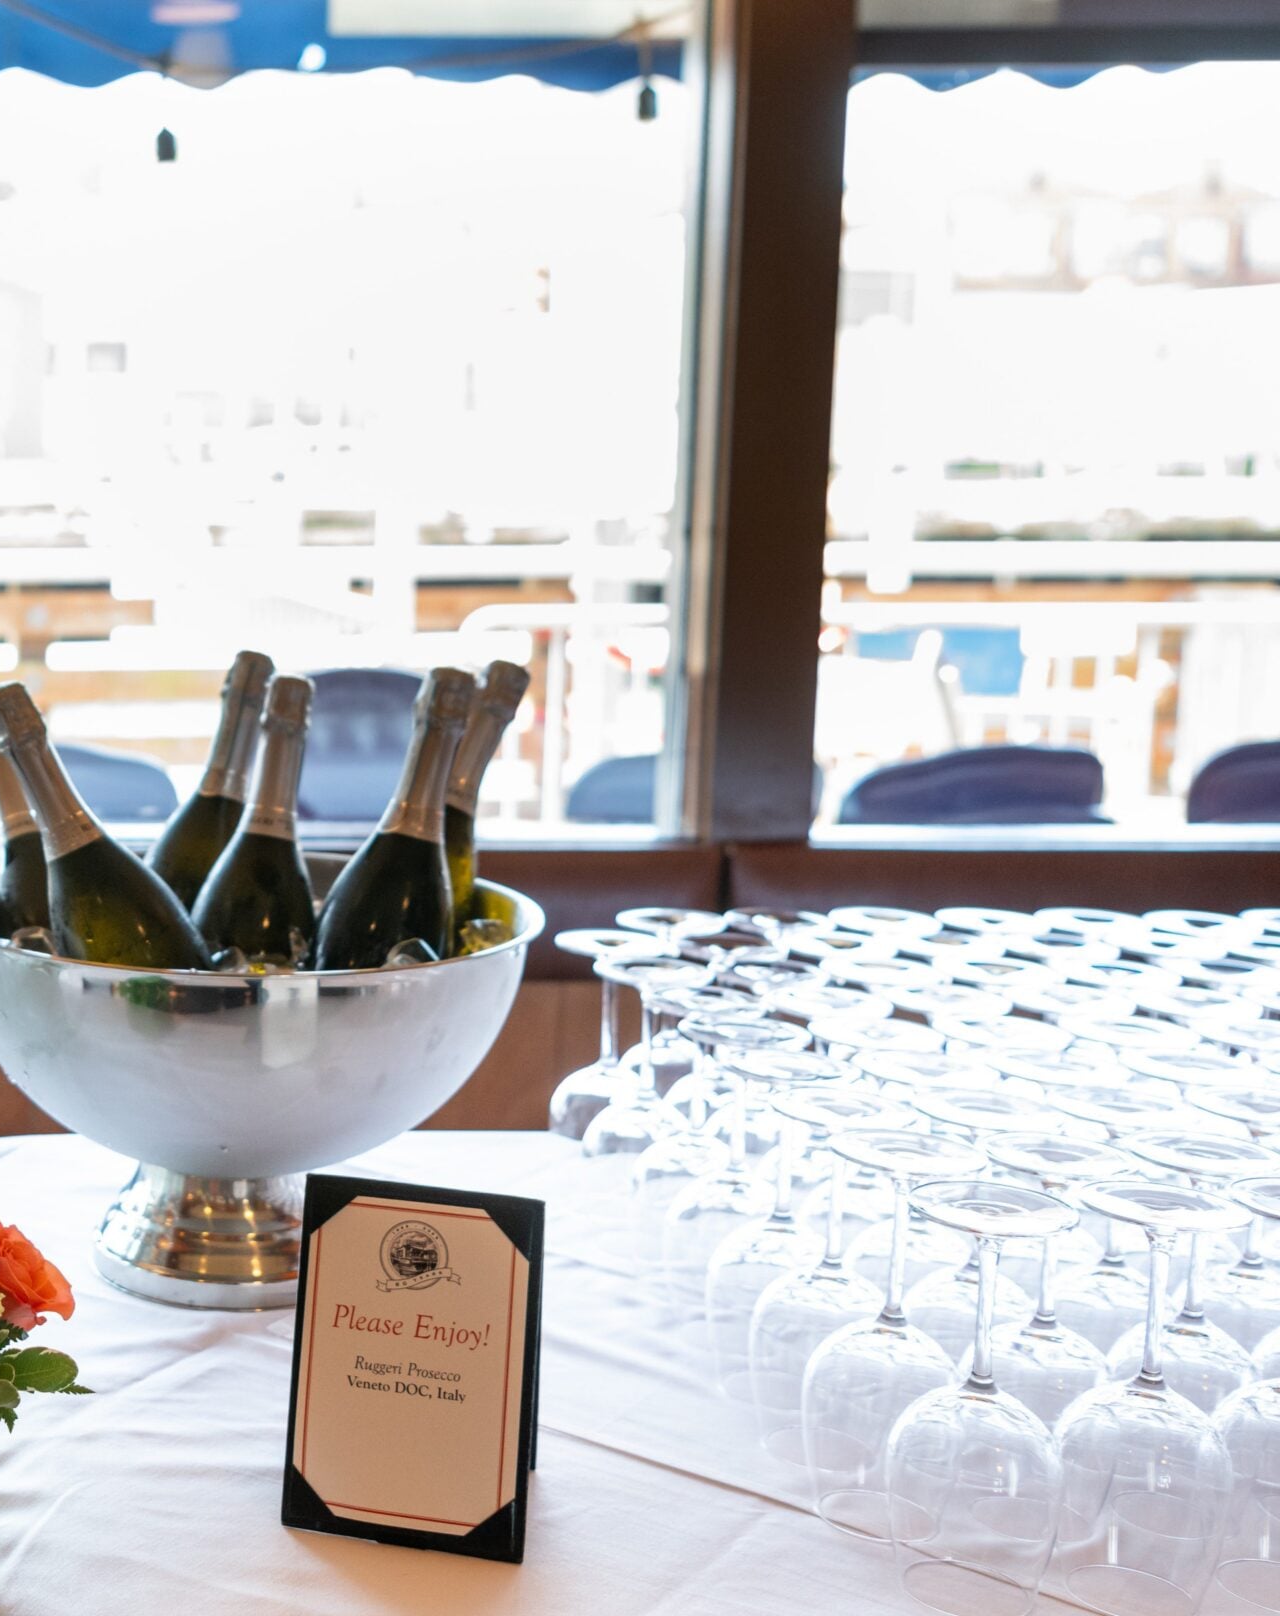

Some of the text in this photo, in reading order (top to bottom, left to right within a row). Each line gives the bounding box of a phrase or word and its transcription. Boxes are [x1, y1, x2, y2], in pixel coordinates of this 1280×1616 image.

[331, 1303, 491, 1351] Please Enjoy!
[354, 1355, 461, 1382] Ruggeri Prosecco
[346, 1374, 467, 1404] Veneto DOC, Italy
